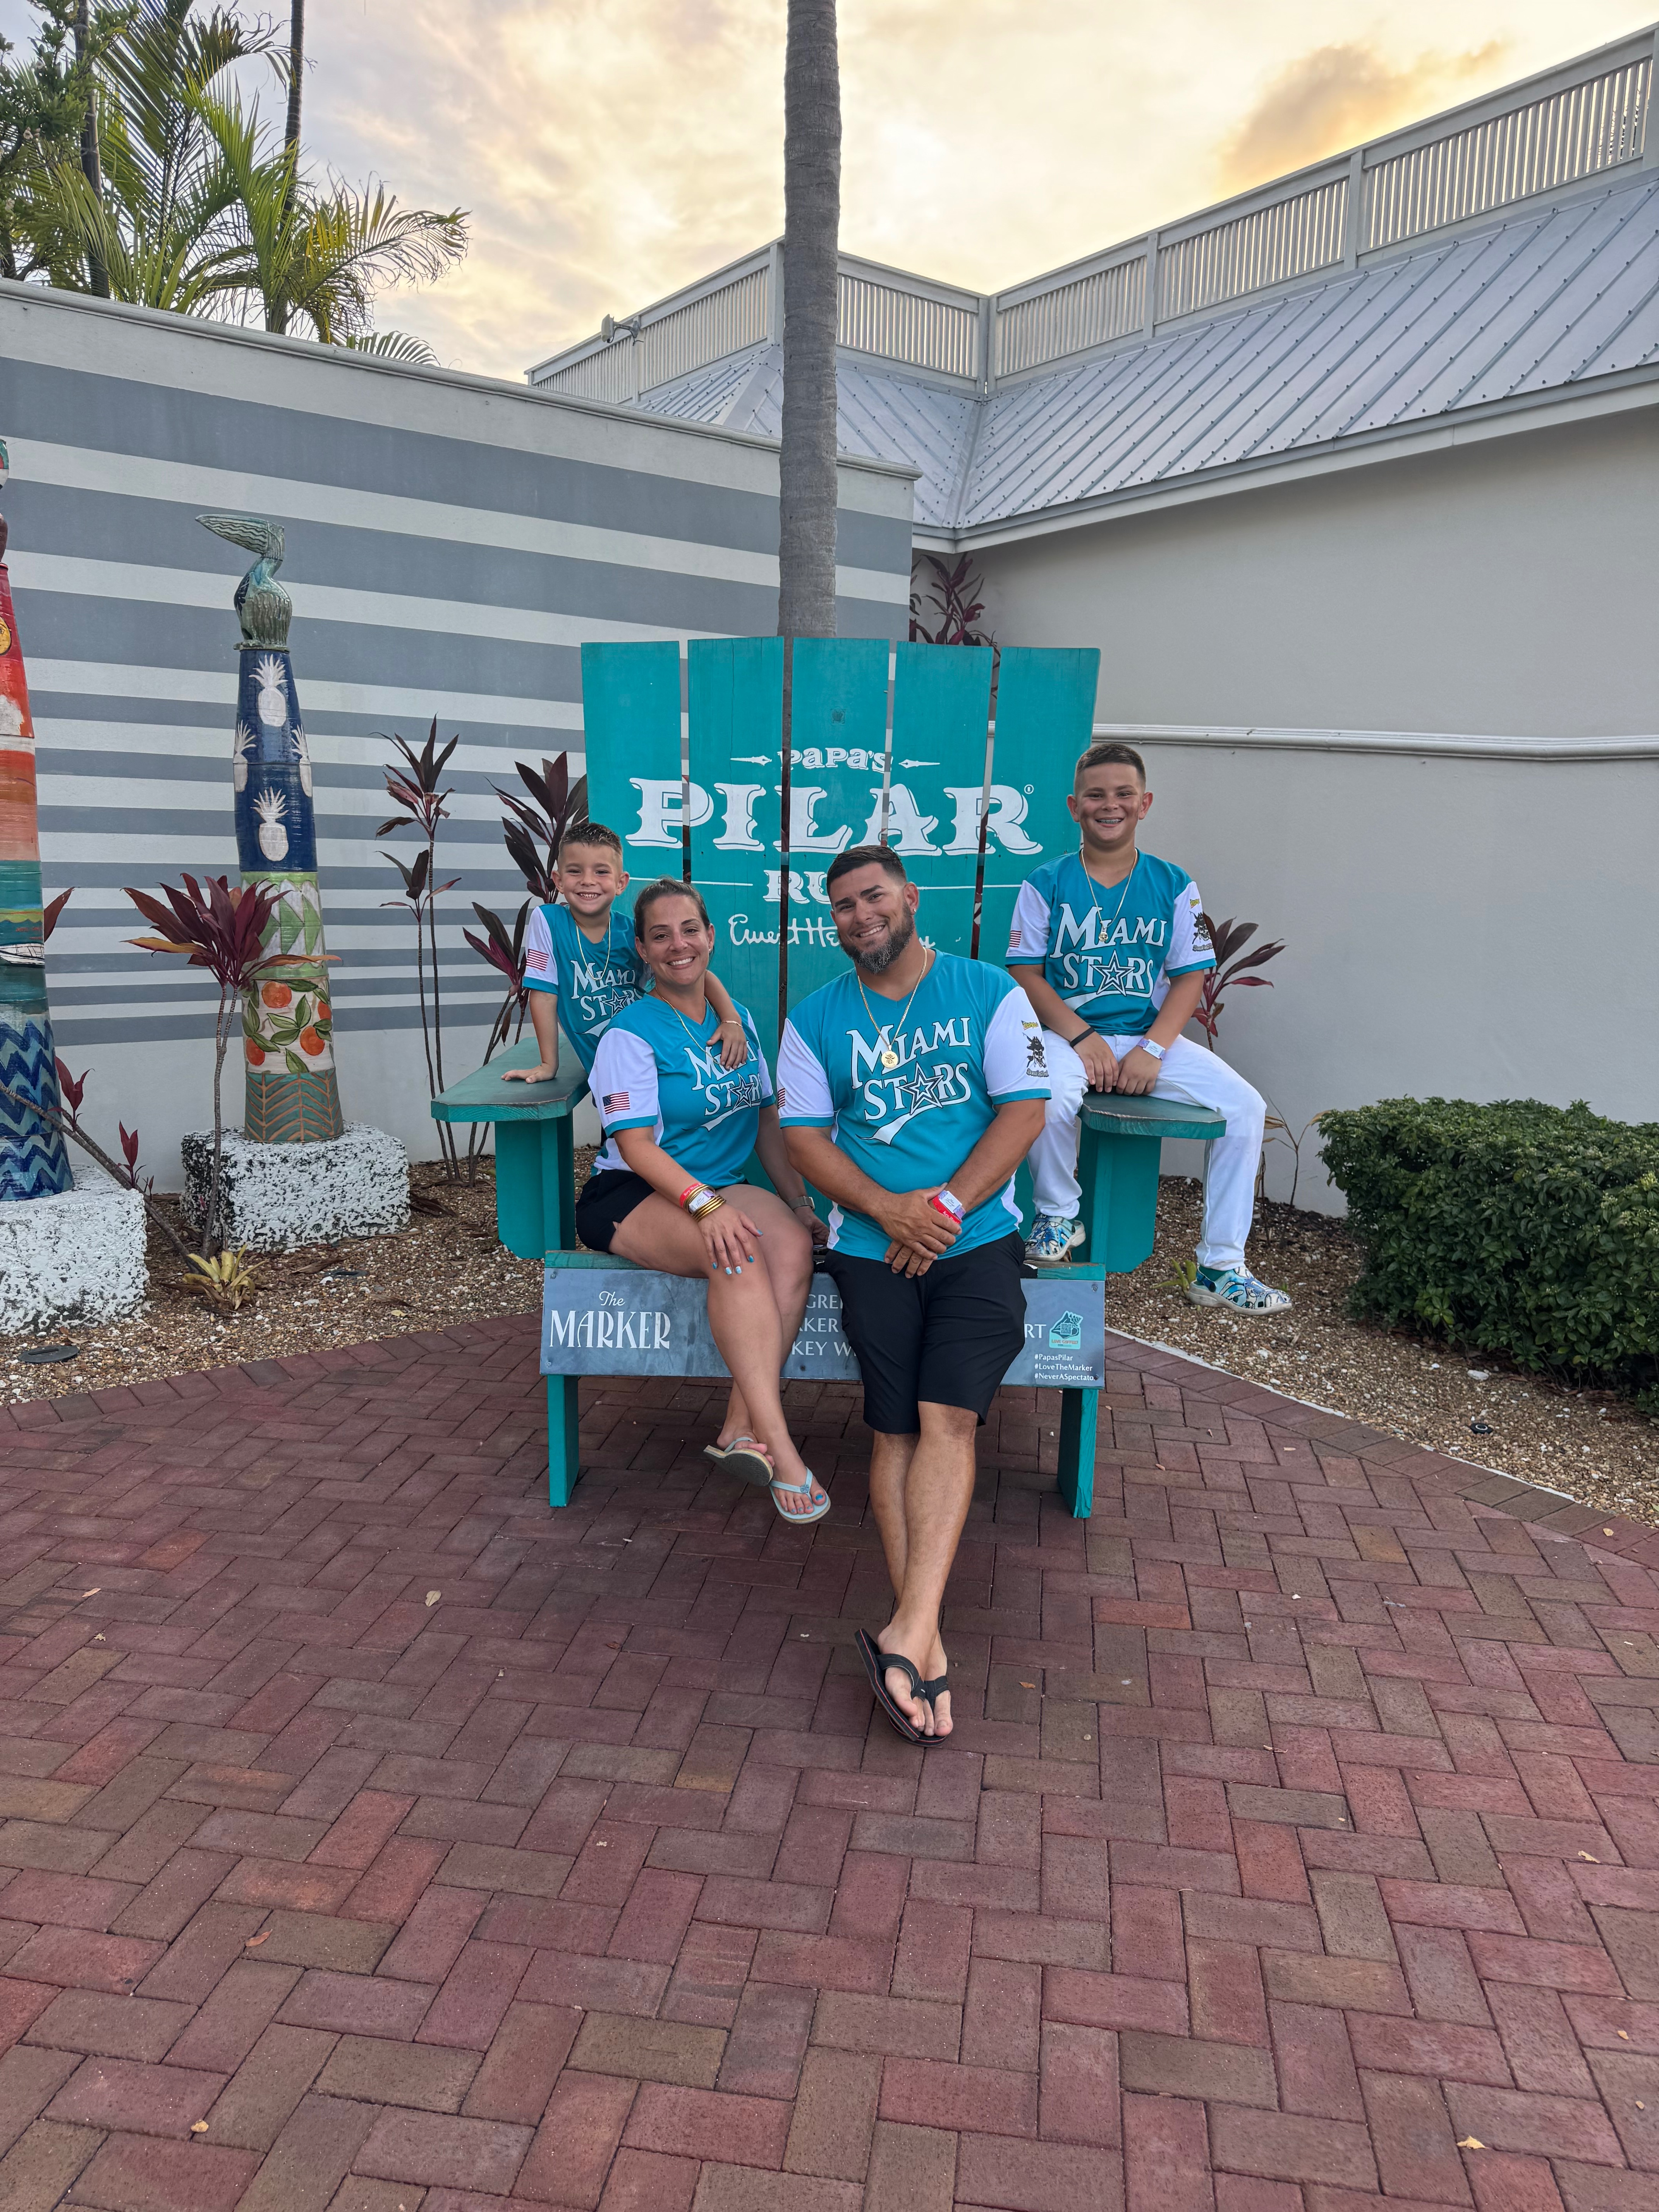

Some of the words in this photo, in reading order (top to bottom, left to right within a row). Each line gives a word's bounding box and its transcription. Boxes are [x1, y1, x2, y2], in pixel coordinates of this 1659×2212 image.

[1049, 903, 1168, 958] MIAMI
[570, 960, 636, 999] MIAMI
[846, 1017, 971, 1089] MIAMI
[599, 1291, 625, 1306] The
[549, 1310, 671, 1349] MARKER
[792, 1341, 828, 1356] KEY
[1034, 1354, 1073, 1362] #PapasPilar
[1034, 1363, 1093, 1372] #LoveTheMarker
[1034, 1372, 1096, 1381] #NeverASpectato
